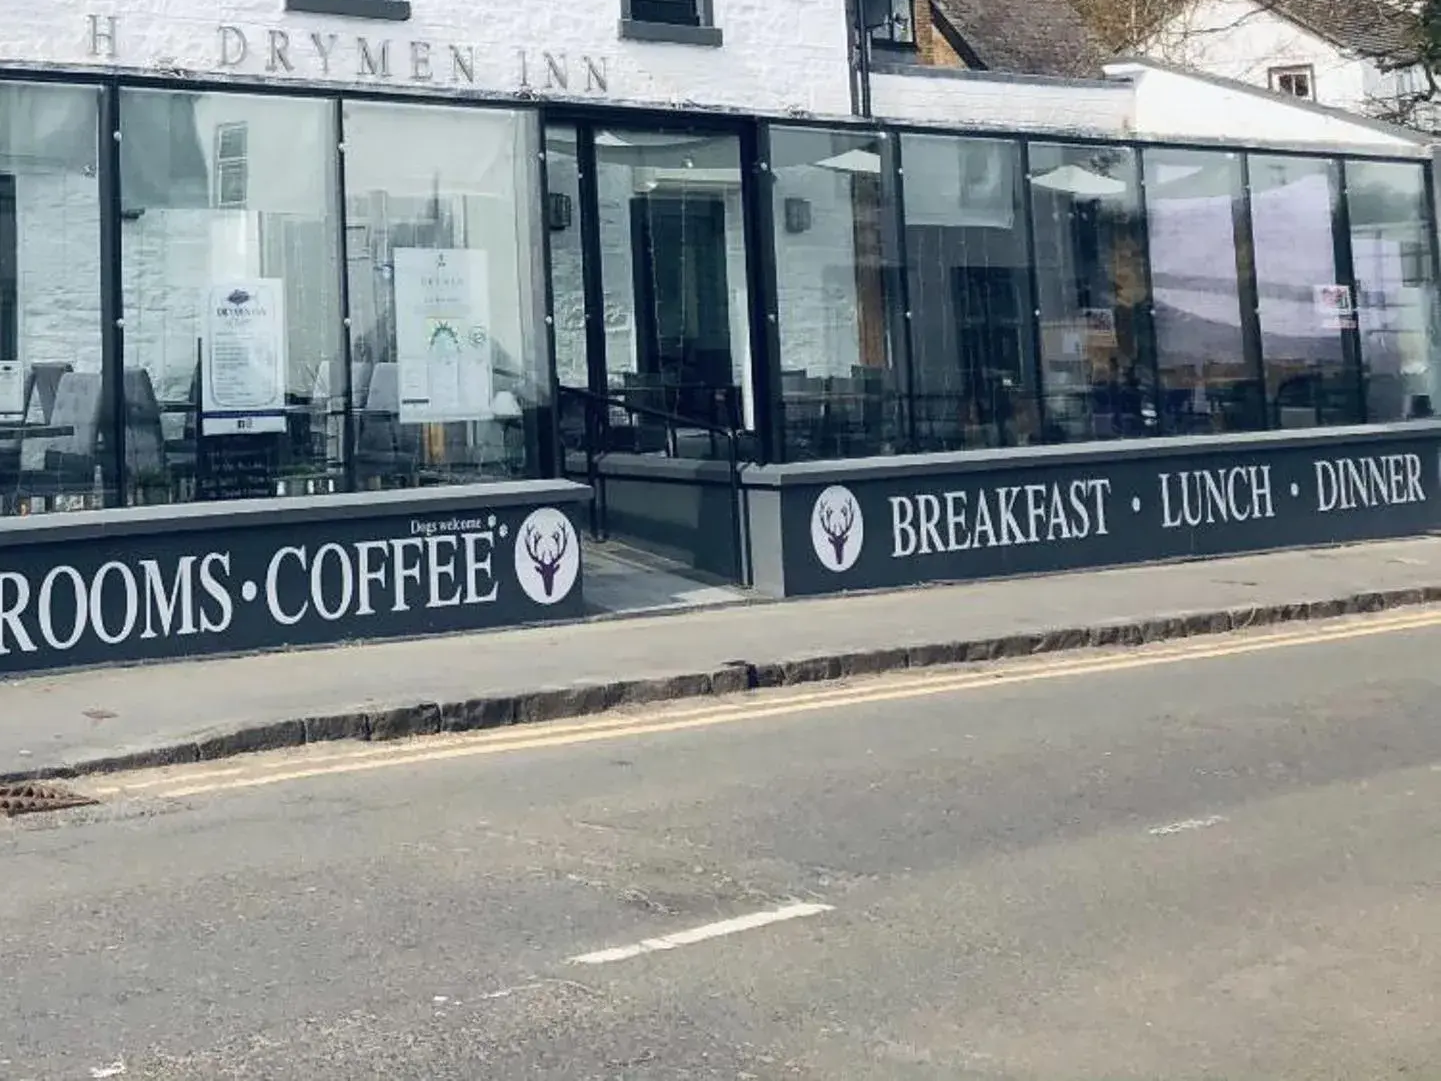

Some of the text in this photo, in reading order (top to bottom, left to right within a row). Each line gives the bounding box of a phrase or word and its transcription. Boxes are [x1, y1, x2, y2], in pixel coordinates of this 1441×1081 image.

[217, 25, 474, 83] DRYMEN
[516, 50, 608, 92] INN
[411, 518, 481, 536] Dogs welcome
[890, 478, 1110, 558] BREAKFAST
[1160, 465, 1274, 528] LUNCH
[1314, 453, 1426, 512] DINNER
[265, 531, 500, 624] COFFEE
